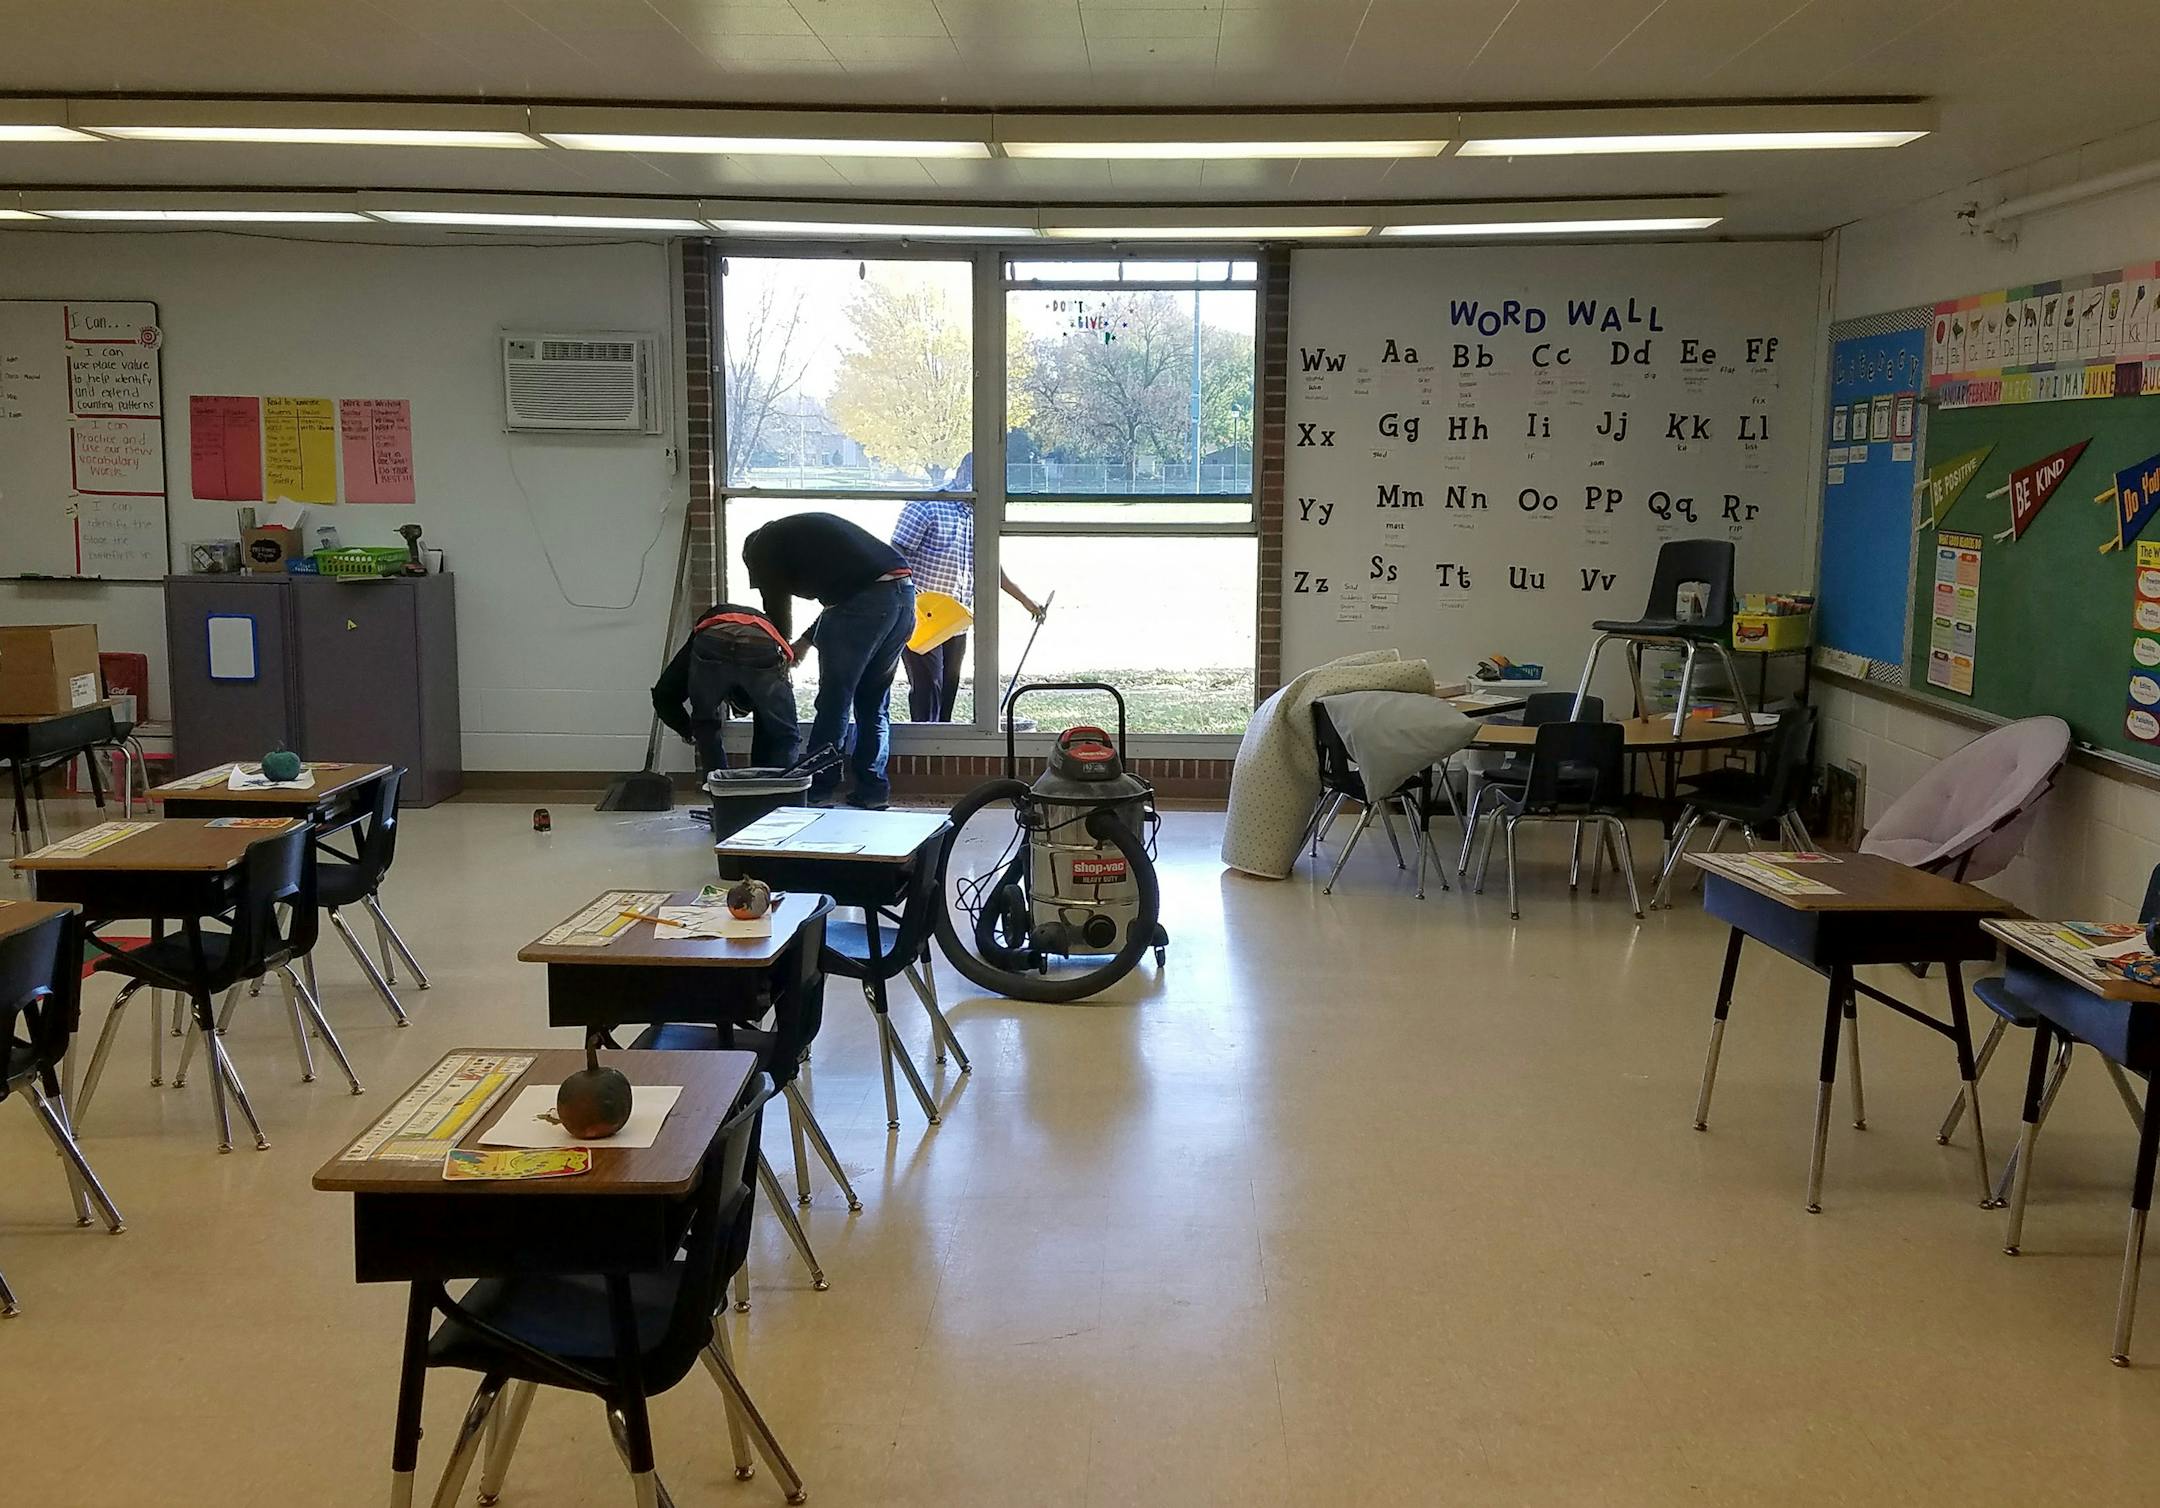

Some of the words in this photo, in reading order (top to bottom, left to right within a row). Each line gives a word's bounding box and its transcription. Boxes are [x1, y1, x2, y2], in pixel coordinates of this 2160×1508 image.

[1053, 300, 1083, 313] DO'T
[1451, 301, 1545, 336] WORD
[1569, 298, 1663, 332] WALL
[1078, 316, 1104, 329] GIVE
[85, 348, 93, 356] I
[102, 348, 124, 357] can
[1301, 348, 1346, 371] Ww
[1382, 340, 1418, 363] Aa
[1453, 344, 1493, 368] Bb
[1533, 344, 1571, 367] Cc
[1611, 340, 1651, 365] Dd
[1680, 340, 1716, 364] Ee
[1746, 338, 1778, 362] Ff
[73, 362, 91, 370] use
[93, 361, 117, 372] place
[122, 359, 150, 370] value
[73, 375, 82, 384] to
[88, 374, 110, 385] help
[115, 374, 152, 386] identify
[2064, 371, 2086, 396] MAY
[2085, 371, 2115, 395] JUNE
[74, 387, 95, 398] and
[102, 387, 140, 398] extend
[119, 401, 154, 411] patterns
[1297, 423, 1335, 446] Xx
[1379, 413, 1419, 442] Gg
[1449, 416, 1488, 440] Hh
[1527, 413, 1550, 437] Ii
[1597, 412, 1627, 441] Jj
[1666, 413, 1710, 440] Kk
[1738, 416, 1768, 440] Ll
[122, 432, 146, 445] and
[79, 455, 140, 469] vocabulary
[1933, 480, 1944, 507] BE
[1945, 458, 1978, 495] POSITIVE
[2015, 477, 2032, 518] BE
[2036, 458, 2065, 496] KIND
[1377, 485, 1423, 507] Mm
[1445, 486, 1487, 508] Nn
[1519, 489, 1557, 511] Oo
[1586, 487, 1622, 512] Pp
[1649, 492, 1697, 522] Qq
[2124, 488, 2139, 523] Do
[1299, 498, 1333, 525] Yy
[1722, 495, 1759, 522] Rr
[2141, 545, 2153, 558] The
[1371, 556, 1397, 581] Ss
[1436, 564, 1470, 588] Tt
[1510, 567, 1544, 589] Uu
[1581, 569, 1616, 591] Vv
[1295, 572, 1328, 592] Zz
